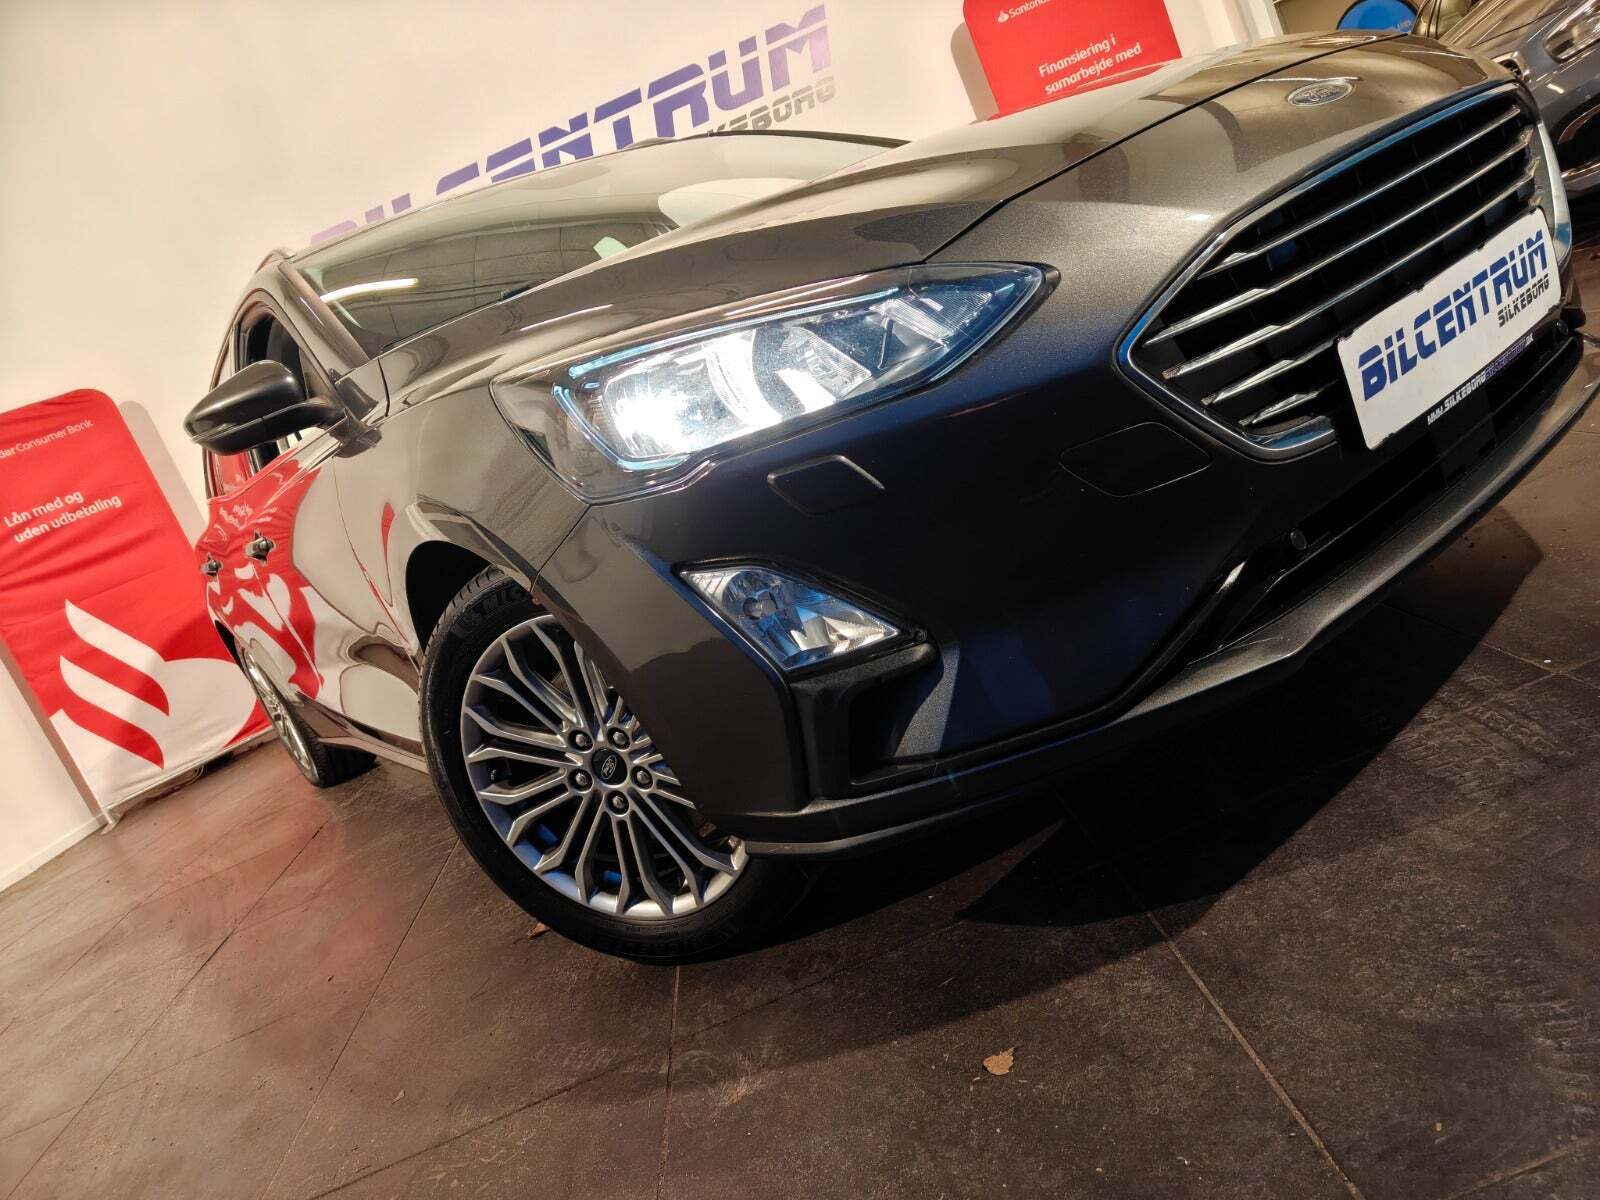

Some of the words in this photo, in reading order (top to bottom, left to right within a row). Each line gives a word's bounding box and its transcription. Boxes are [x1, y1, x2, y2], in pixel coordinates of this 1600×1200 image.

[1038, 39, 1110, 77] Finansiering
[1111, 34, 1117, 46] i
[1045, 57, 1114, 96] samarbejde
[1115, 42, 1142, 64] med
[309, 3, 831, 246] ENTRUM
[1358, 229, 1548, 401] BILCENTRUM
[1497, 273, 1549, 328] SILKEBORG
[16, 428, 66, 451] Consumer
[66, 419, 93, 434] Bank
[3, 511, 32, 528] Lån
[33, 498, 64, 518] med
[65, 491, 85, 503] og
[14, 523, 49, 543] uden
[51, 495, 122, 529] udbetaling
